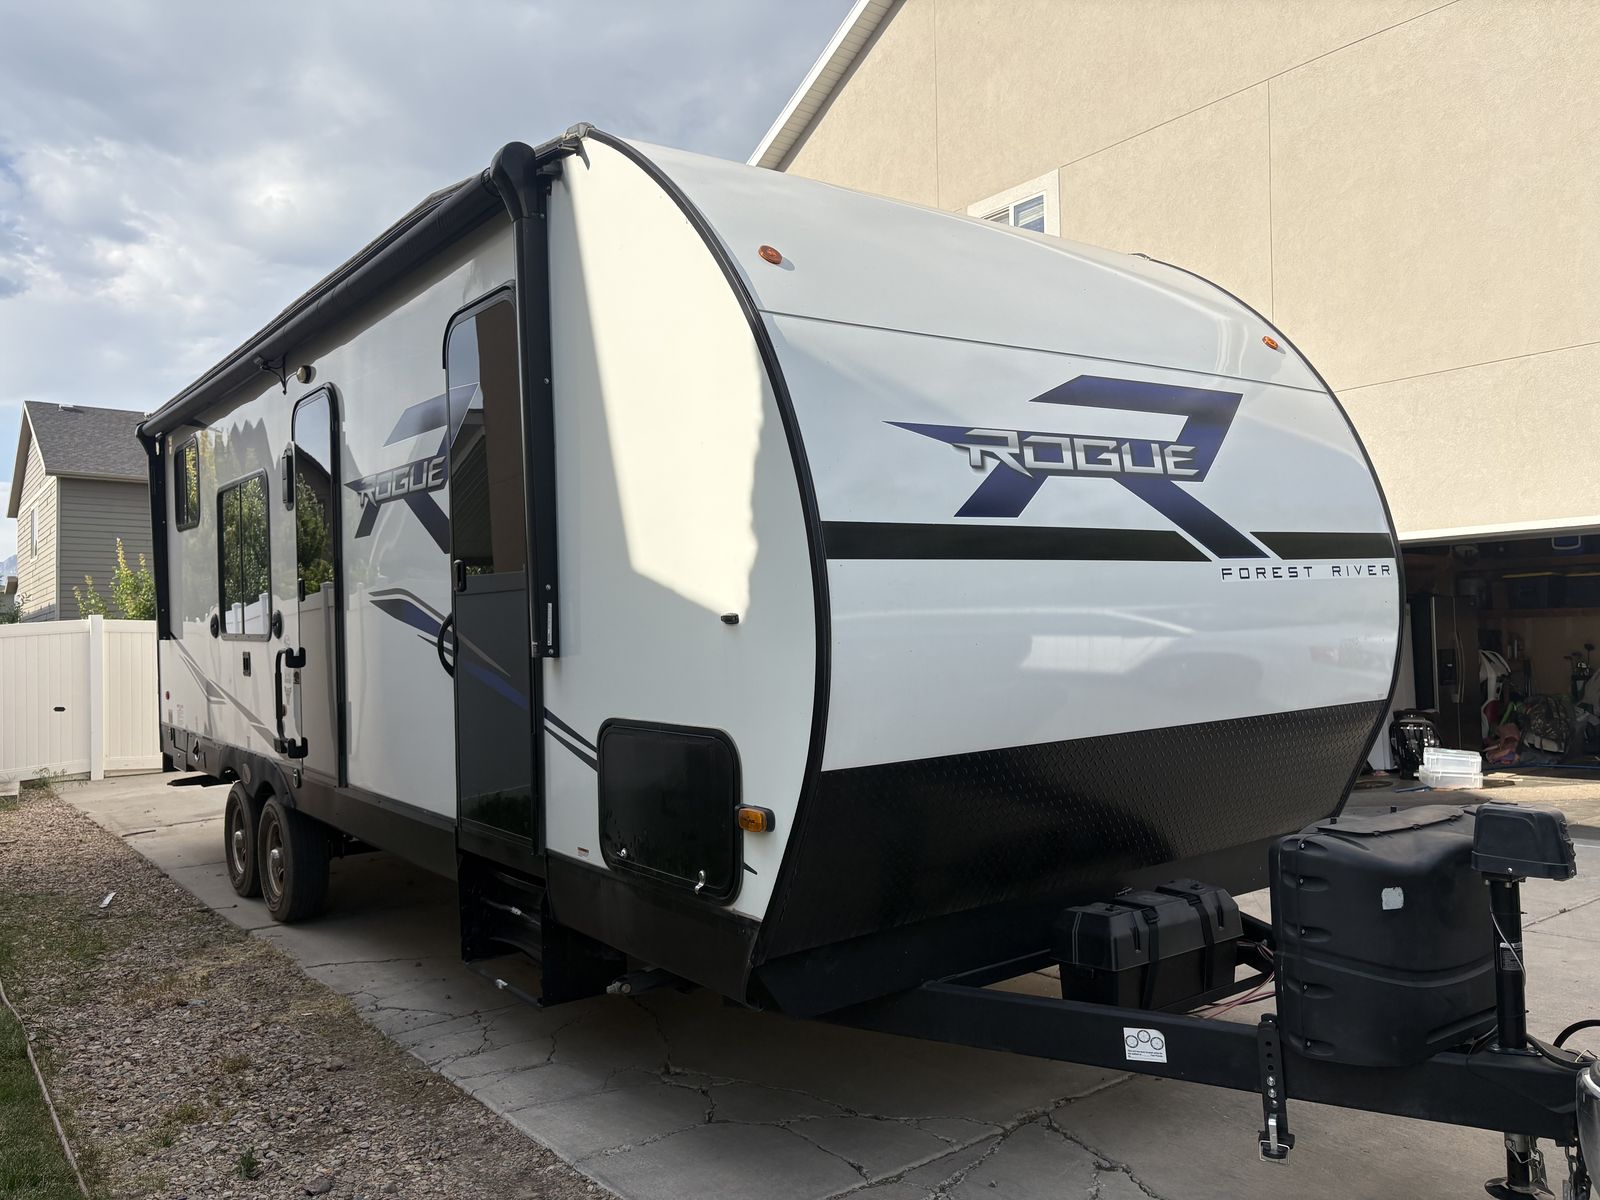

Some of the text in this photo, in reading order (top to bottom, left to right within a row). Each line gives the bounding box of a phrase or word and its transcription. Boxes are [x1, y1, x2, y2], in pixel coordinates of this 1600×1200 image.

[953, 428, 1199, 479] ROGUE
[357, 455, 447, 508] ROGUE
[1221, 565, 1391, 580] FOREST RIVER
